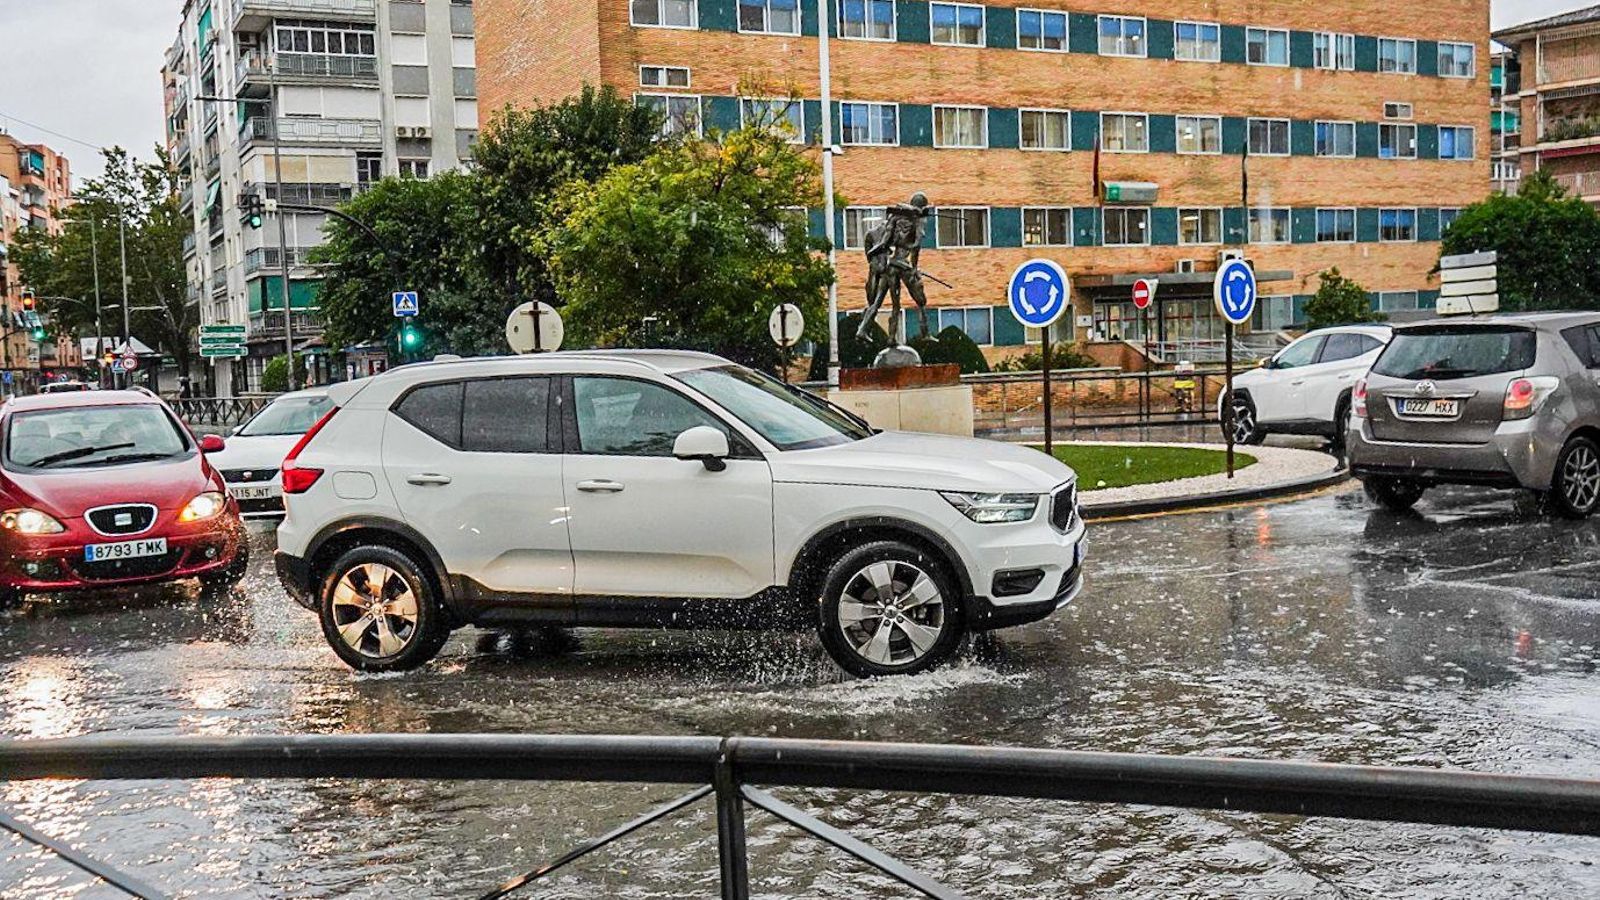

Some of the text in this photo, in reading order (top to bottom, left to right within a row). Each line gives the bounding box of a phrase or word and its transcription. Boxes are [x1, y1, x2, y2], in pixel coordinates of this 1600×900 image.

[1410, 400, 1454, 413] 0227 HXX
[231, 488, 269, 498] 115 JNT
[95, 541, 161, 558] 8793 FMK
